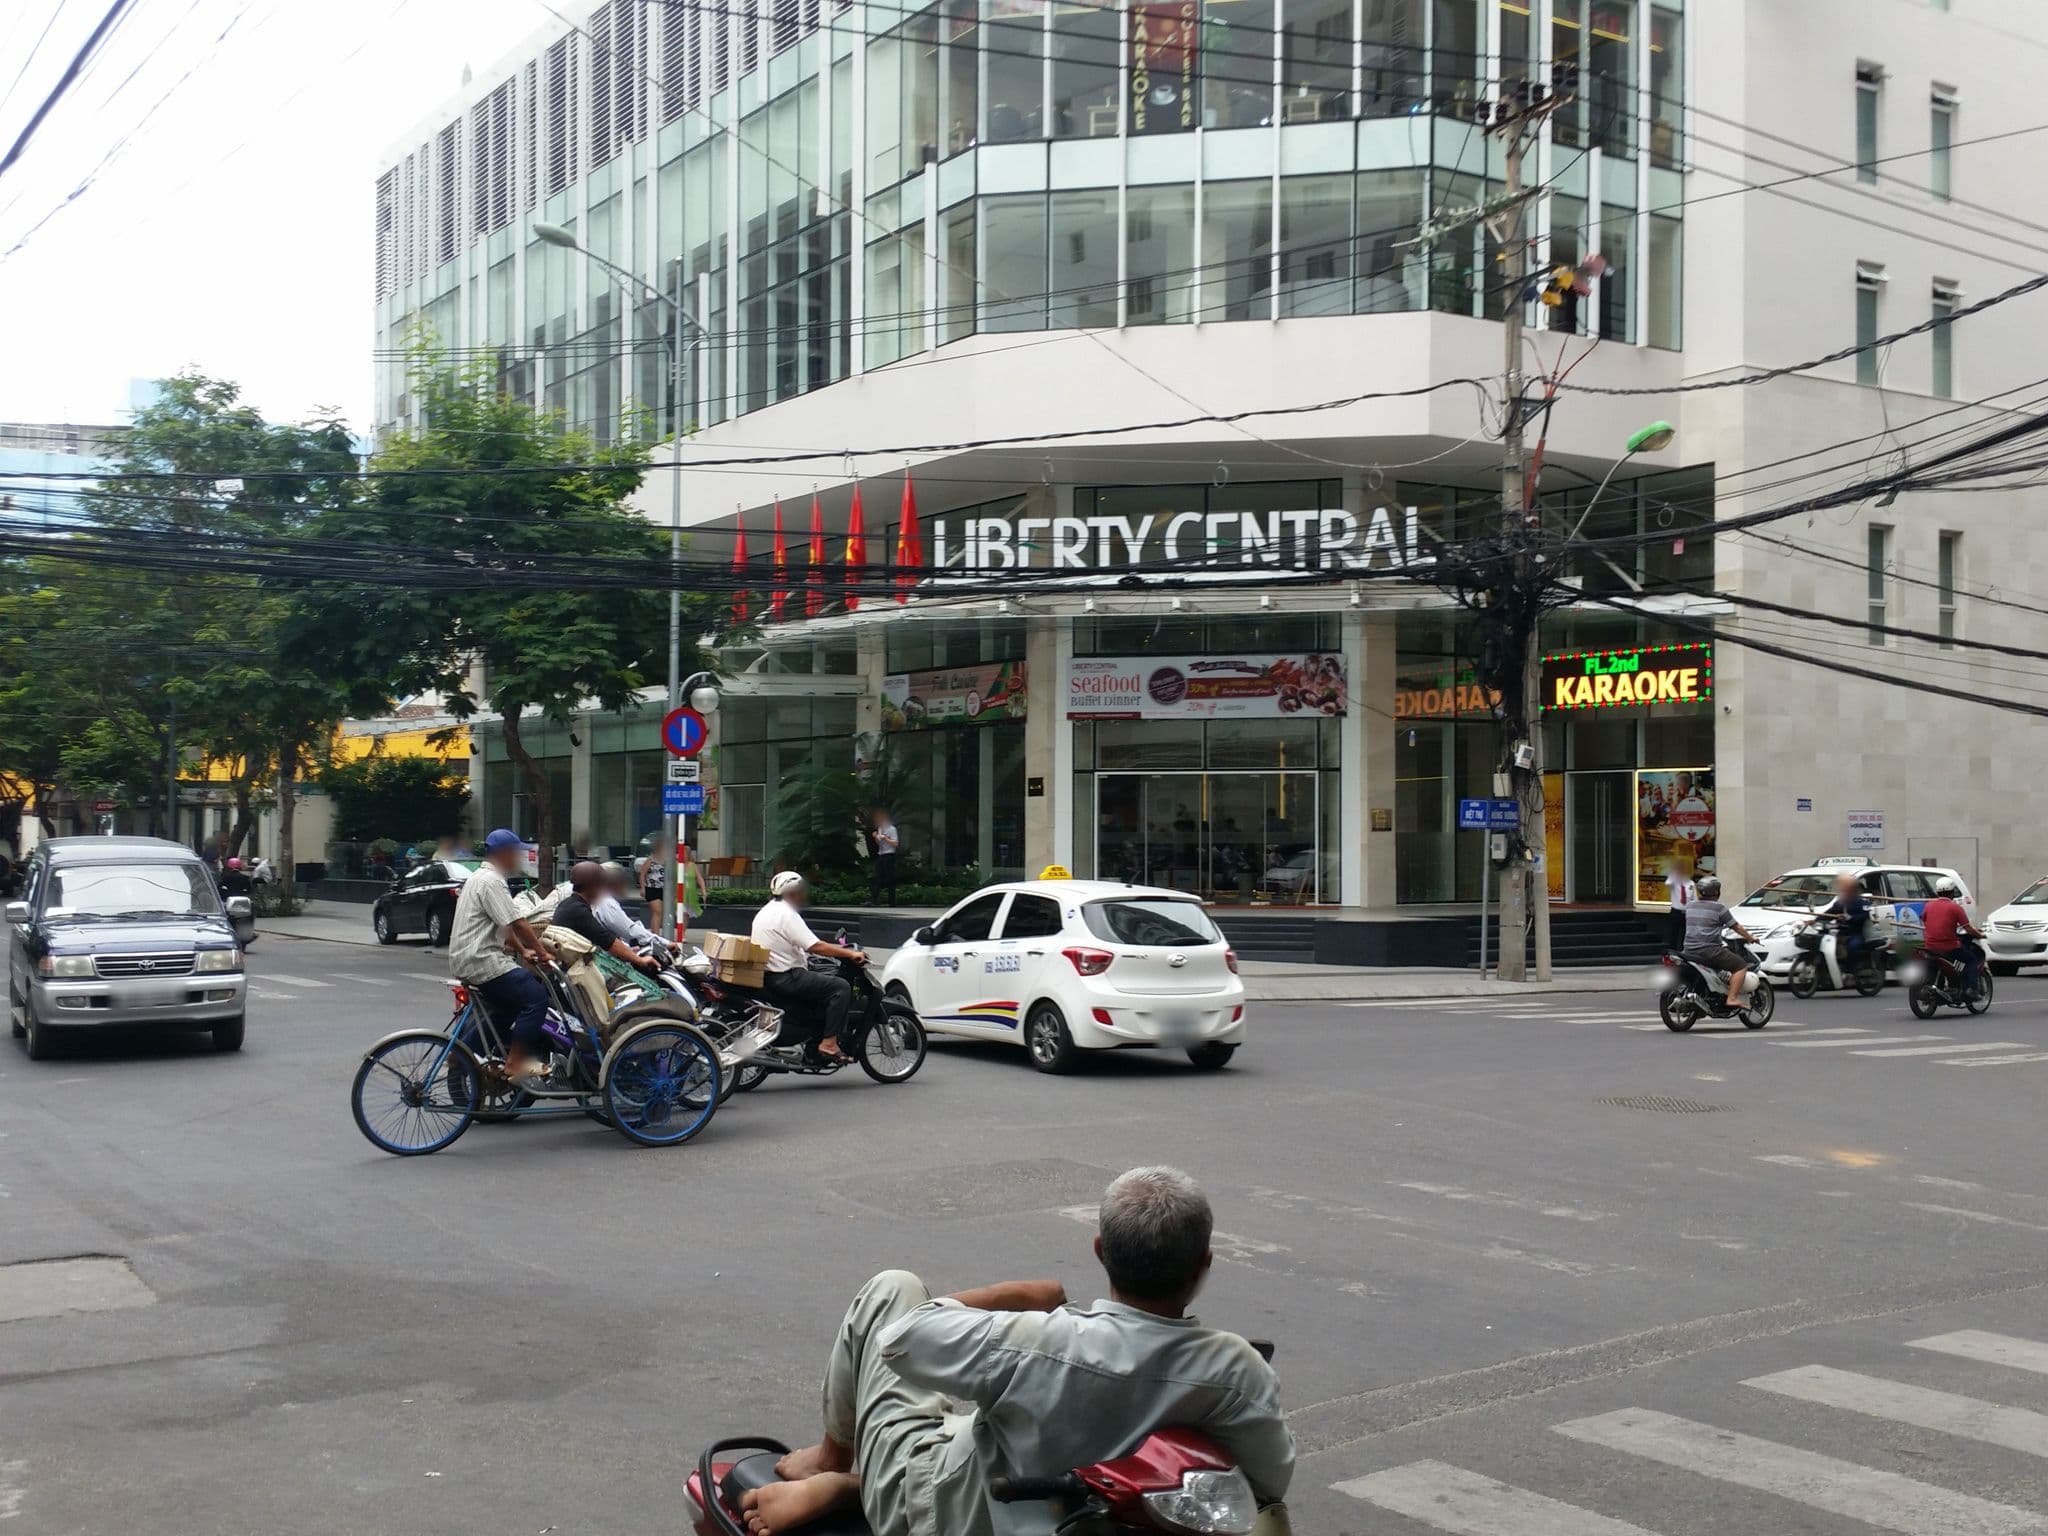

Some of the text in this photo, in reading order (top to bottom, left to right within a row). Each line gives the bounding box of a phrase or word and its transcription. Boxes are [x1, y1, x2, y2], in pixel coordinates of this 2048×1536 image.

[1133, 7, 1149, 130] KARAOKE
[1181, 87, 1192, 127] BAR
[934, 506, 1436, 577] LIBERTY CENTRAL
[1071, 673, 1141, 694] seafood
[1071, 695, 1142, 707] Buffet Dinner
[1555, 668, 1698, 705] KARAOKE
